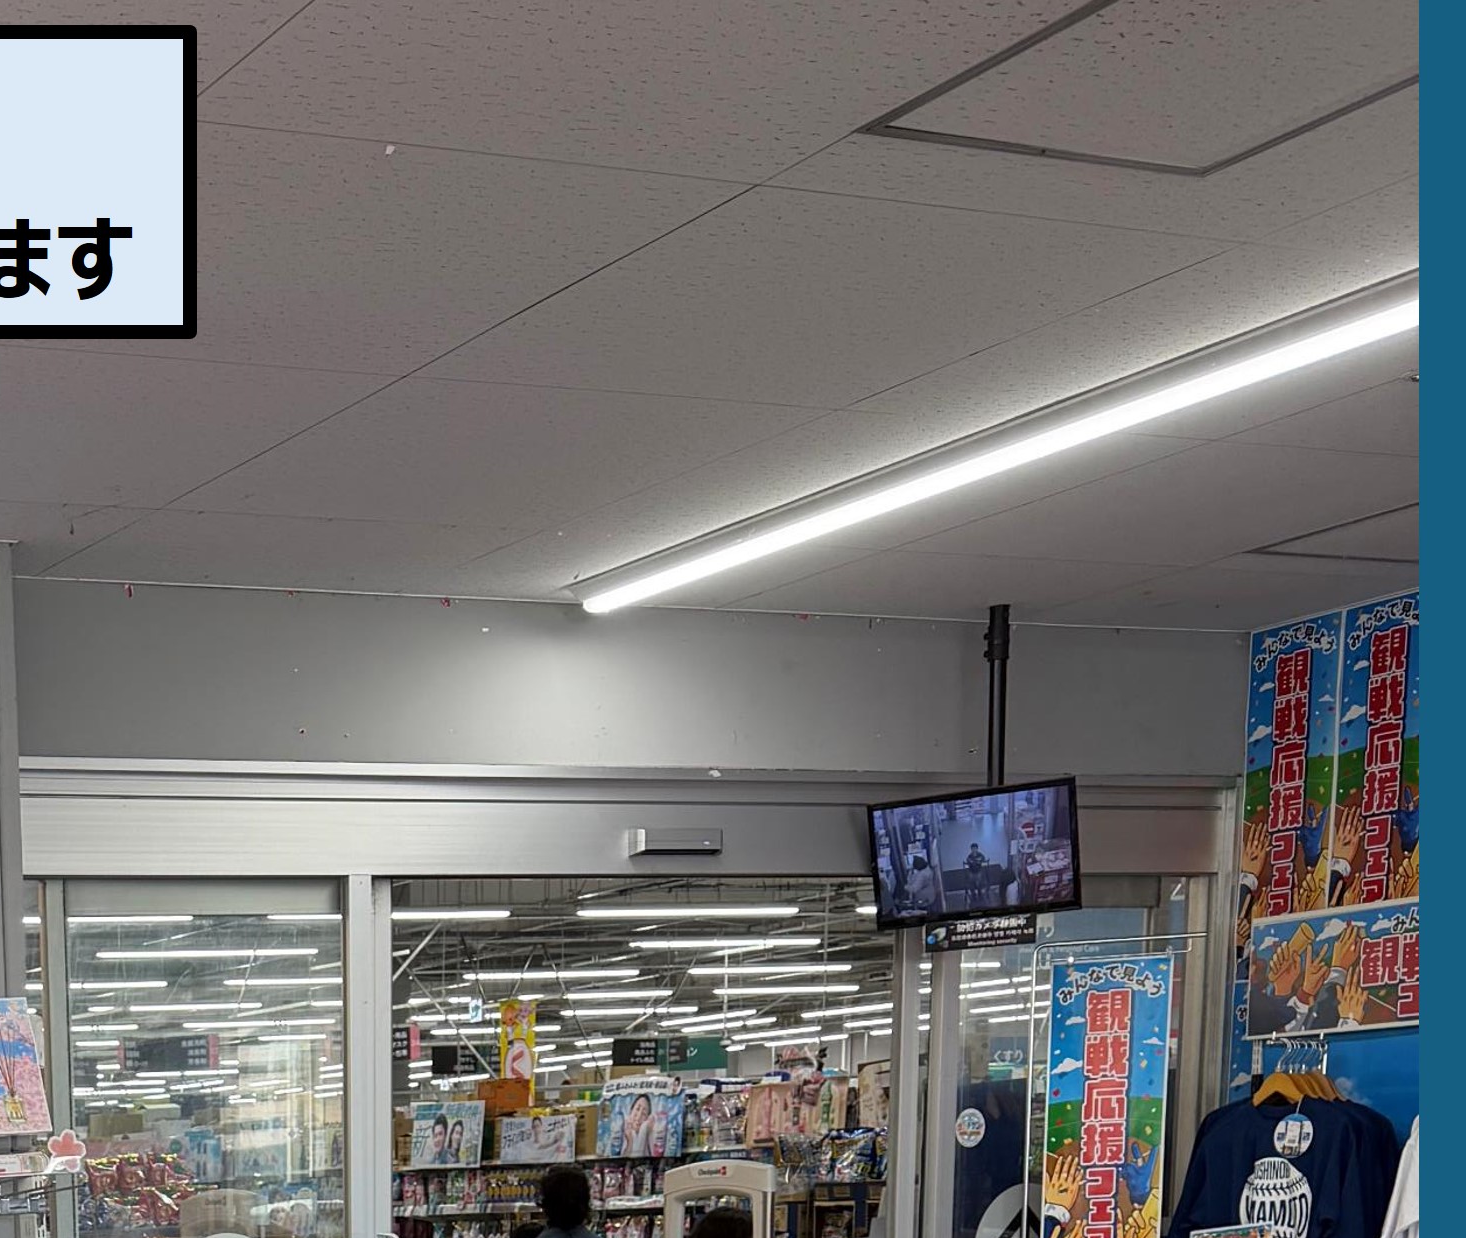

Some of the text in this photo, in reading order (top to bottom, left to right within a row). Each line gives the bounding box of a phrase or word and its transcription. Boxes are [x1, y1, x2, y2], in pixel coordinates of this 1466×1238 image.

[1268, 647, 1312, 917] 観戦応援フェア
[1361, 623, 1409, 905] 観戦応援フェア
[1056, 962, 1166, 1004] みんなで見よう
